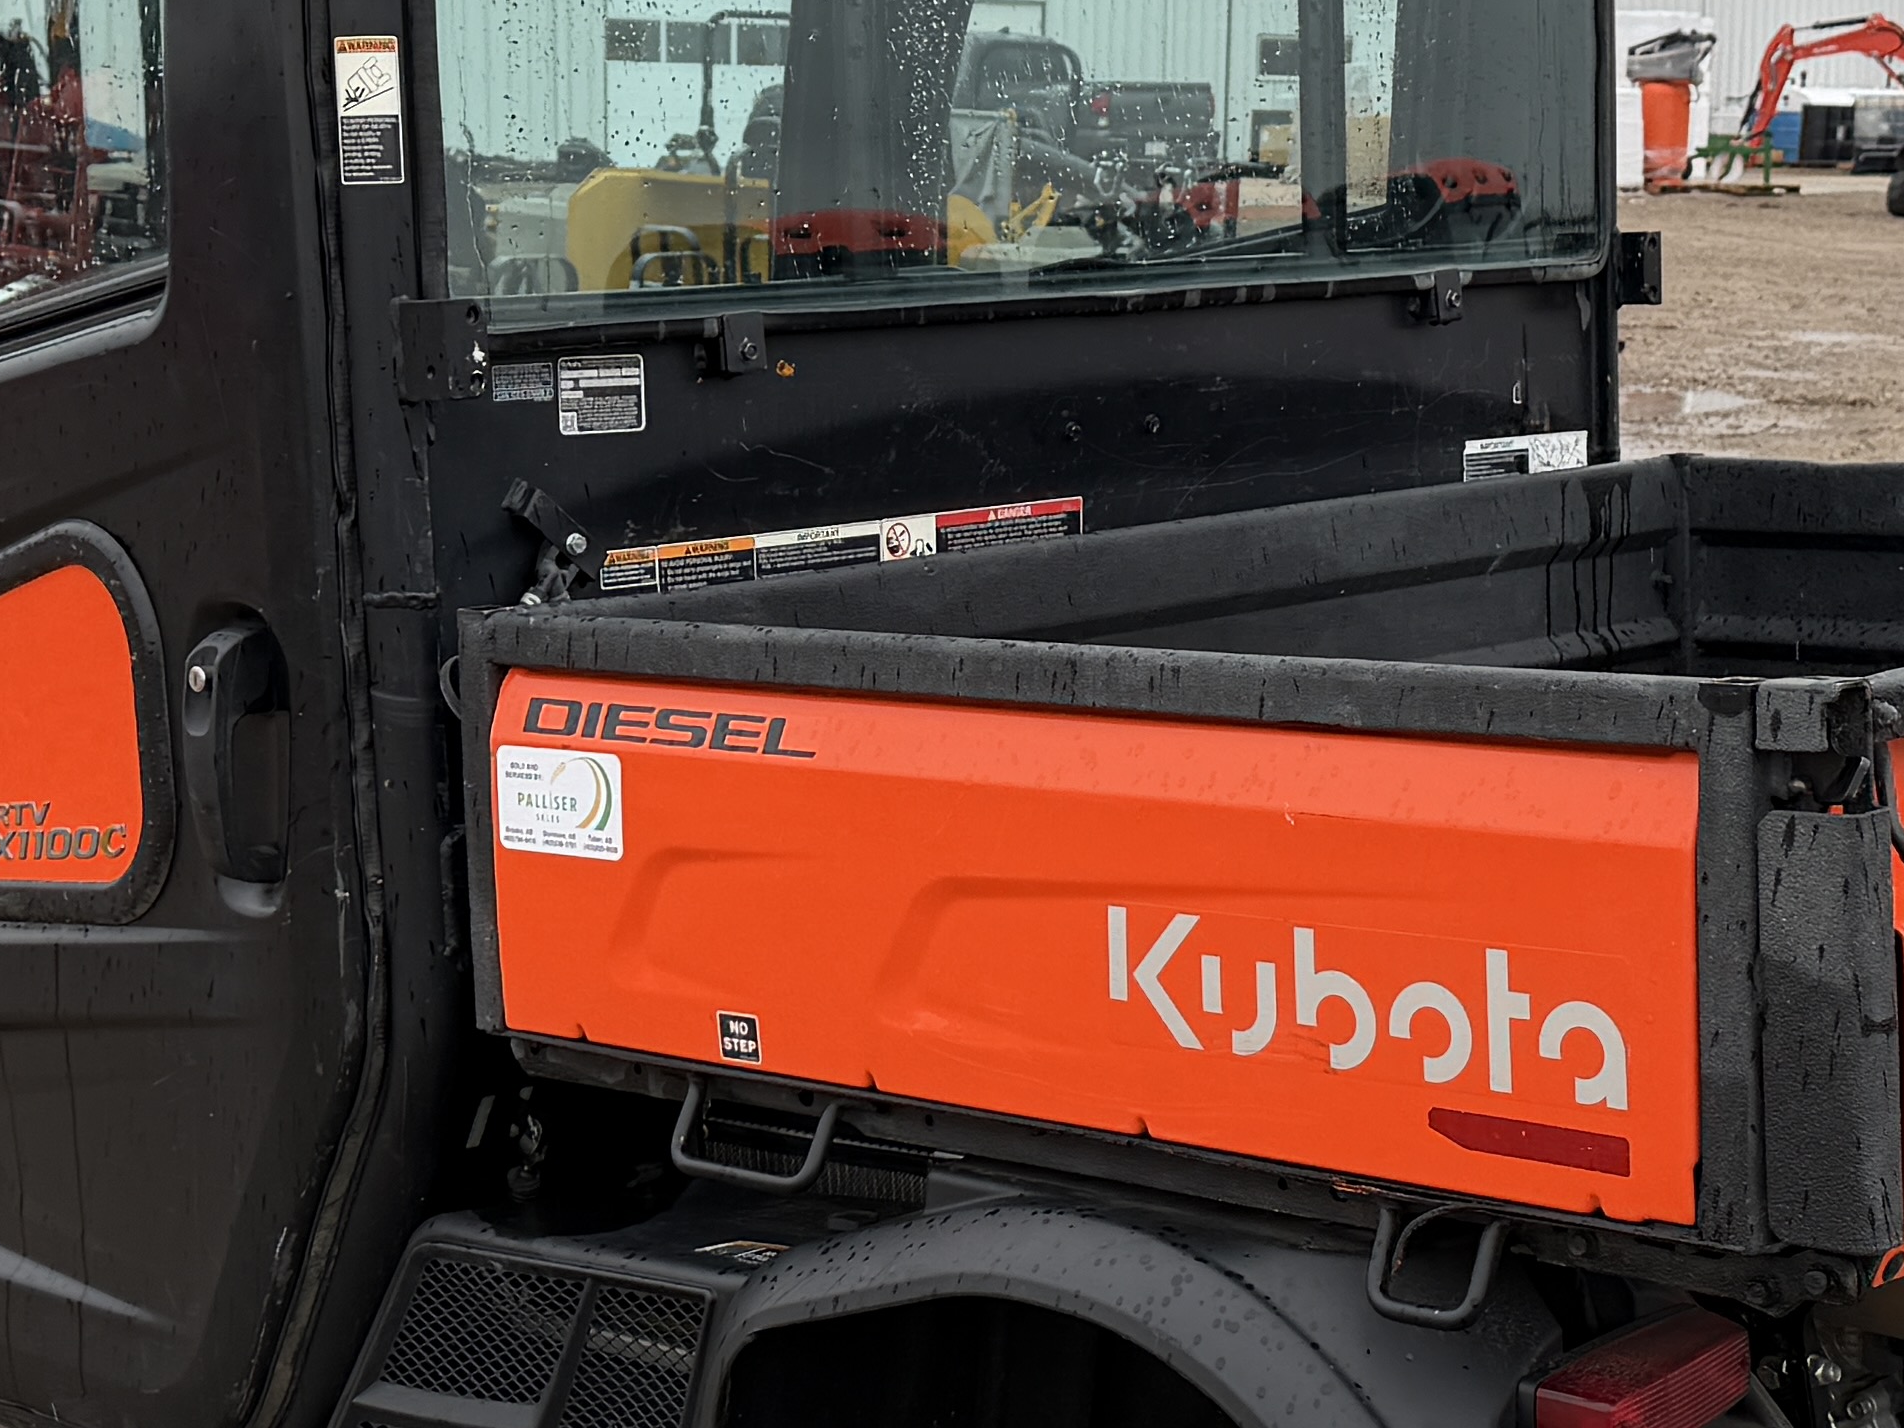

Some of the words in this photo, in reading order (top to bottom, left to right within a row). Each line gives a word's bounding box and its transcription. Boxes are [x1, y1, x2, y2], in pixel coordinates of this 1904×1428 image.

[523, 697, 817, 759] DIESEL
[517, 791, 578, 812] PALLISER
[1108, 906, 1629, 1110] Kubota
[729, 1020, 748, 1035] NO
[723, 1037, 756, 1053] STEP
